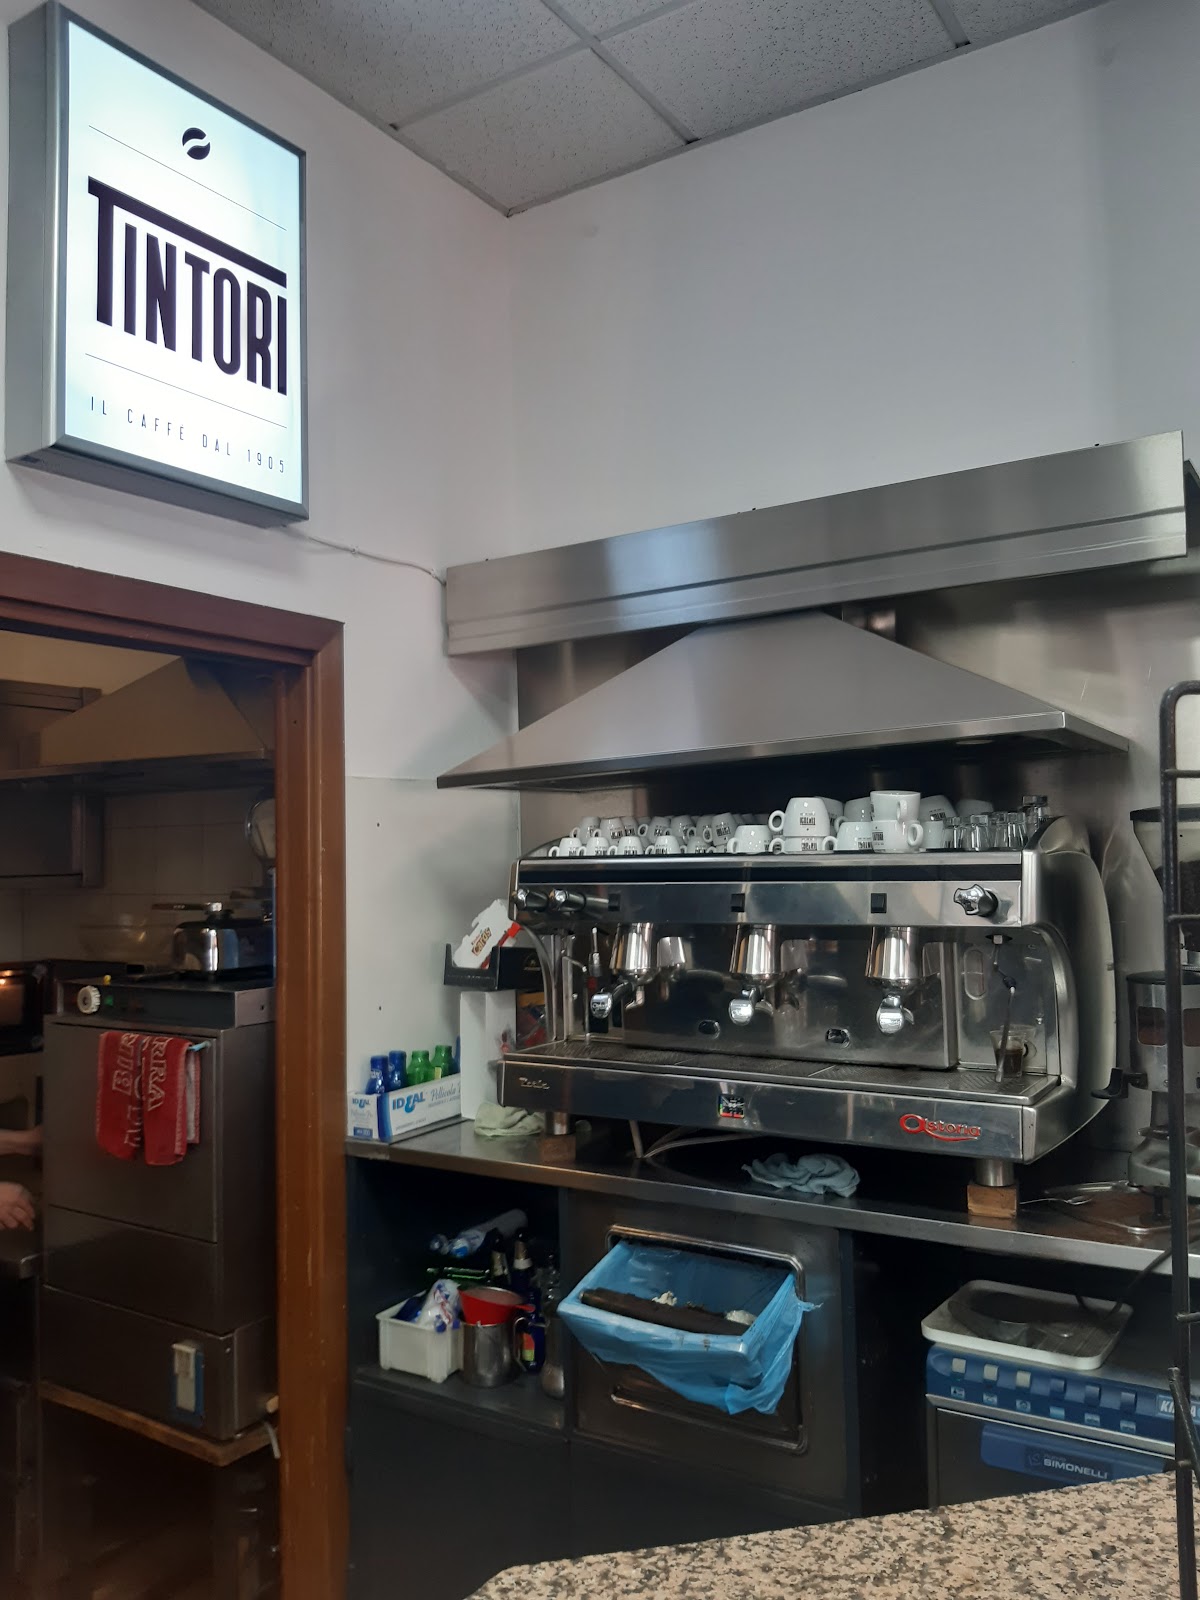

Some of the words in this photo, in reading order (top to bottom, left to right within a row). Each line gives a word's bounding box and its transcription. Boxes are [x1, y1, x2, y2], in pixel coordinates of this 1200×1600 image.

[88, 175, 288, 397] TINTORI
[91, 396, 108, 417] IL
[202, 433, 231, 457] DAL
[246, 449, 284, 474] 1905
[392, 1091, 425, 1114] IDEAL
[1043, 1458, 1109, 1480] SIMONELLI
